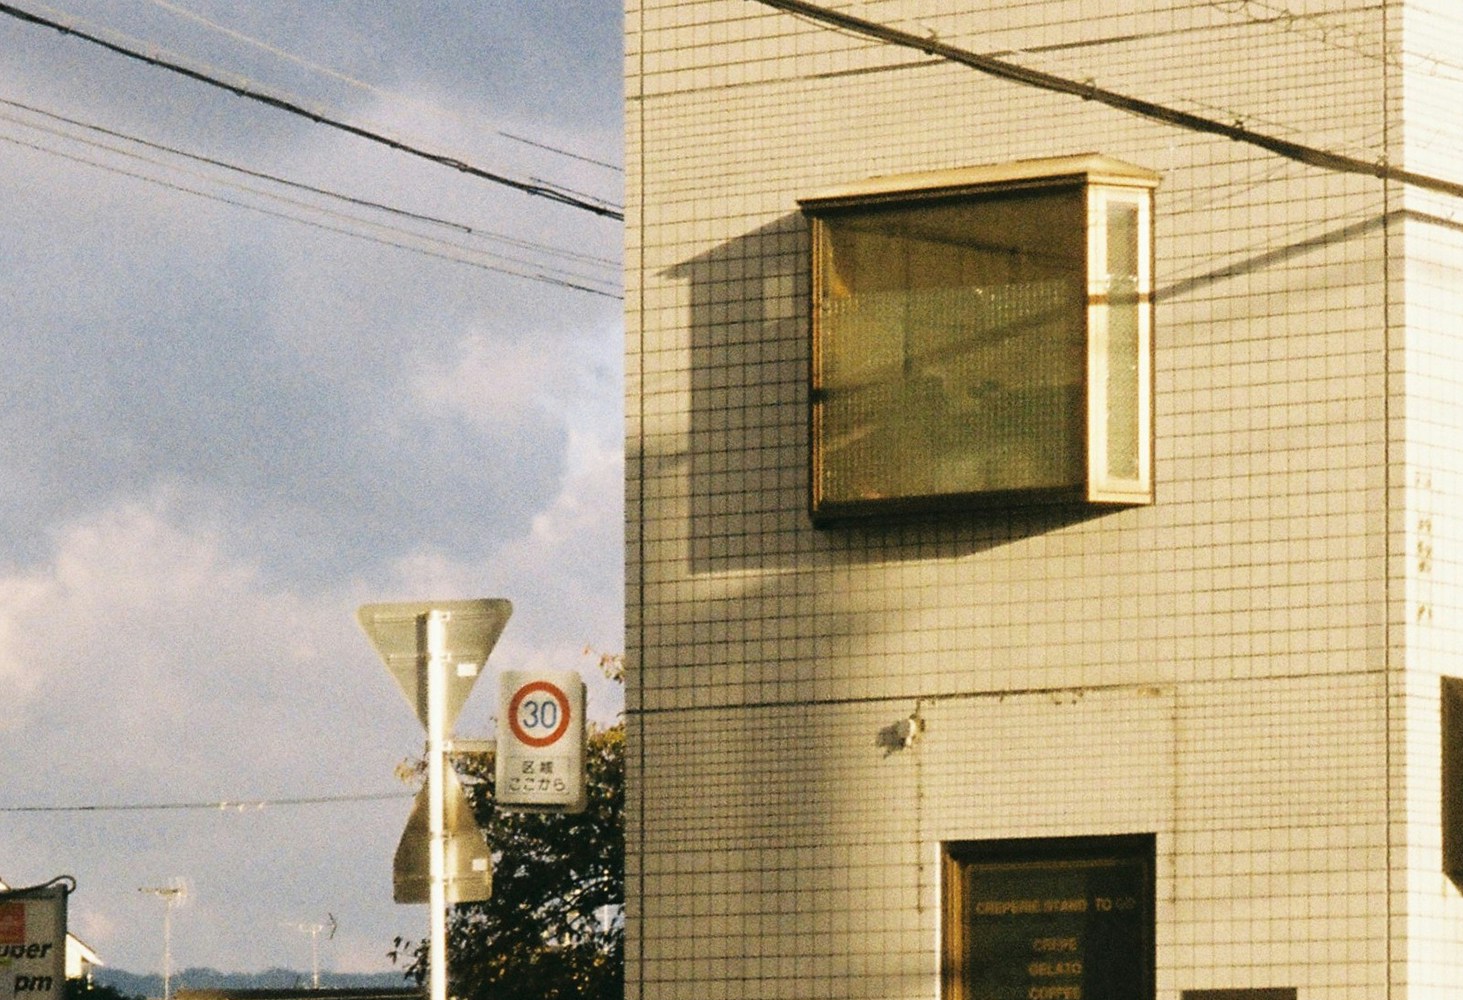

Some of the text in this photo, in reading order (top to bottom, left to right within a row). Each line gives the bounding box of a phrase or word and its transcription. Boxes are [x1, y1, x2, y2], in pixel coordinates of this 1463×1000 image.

[522, 700, 557, 729] 30
[509, 778, 566, 792] ここから
[13, 975, 53, 998] pm
